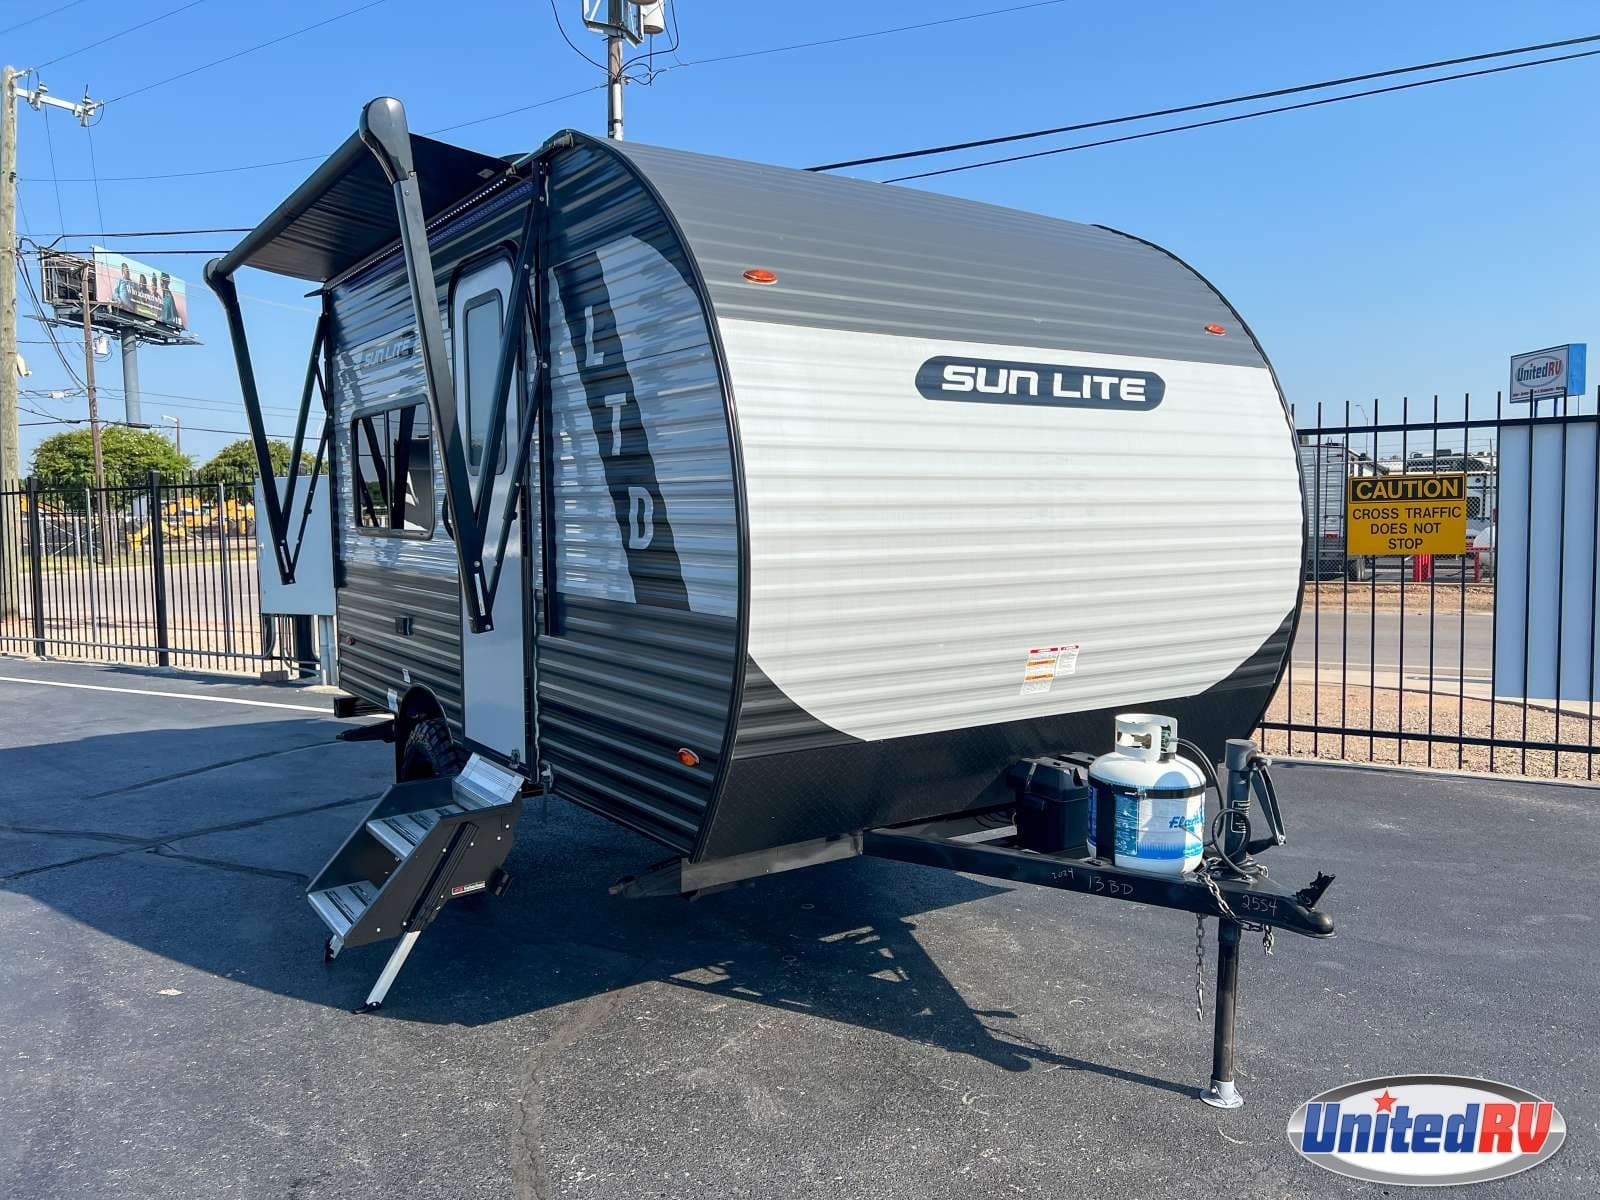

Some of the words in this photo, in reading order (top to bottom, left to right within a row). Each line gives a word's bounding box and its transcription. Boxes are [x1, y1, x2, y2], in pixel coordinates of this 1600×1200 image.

[1517, 360, 1562, 382] UnitedRV
[942, 365, 1039, 396] SUN
[1053, 373, 1146, 401] LITE
[585, 306, 654, 550] LTD
[1356, 479, 1459, 500] CAUTION
[1352, 508, 1399, 520] CROSS
[1405, 506, 1462, 519] TRAFFIC
[1370, 523, 1408, 535] DOES
[1414, 522, 1442, 534] NOT
[1388, 538, 1424, 550] STOP
